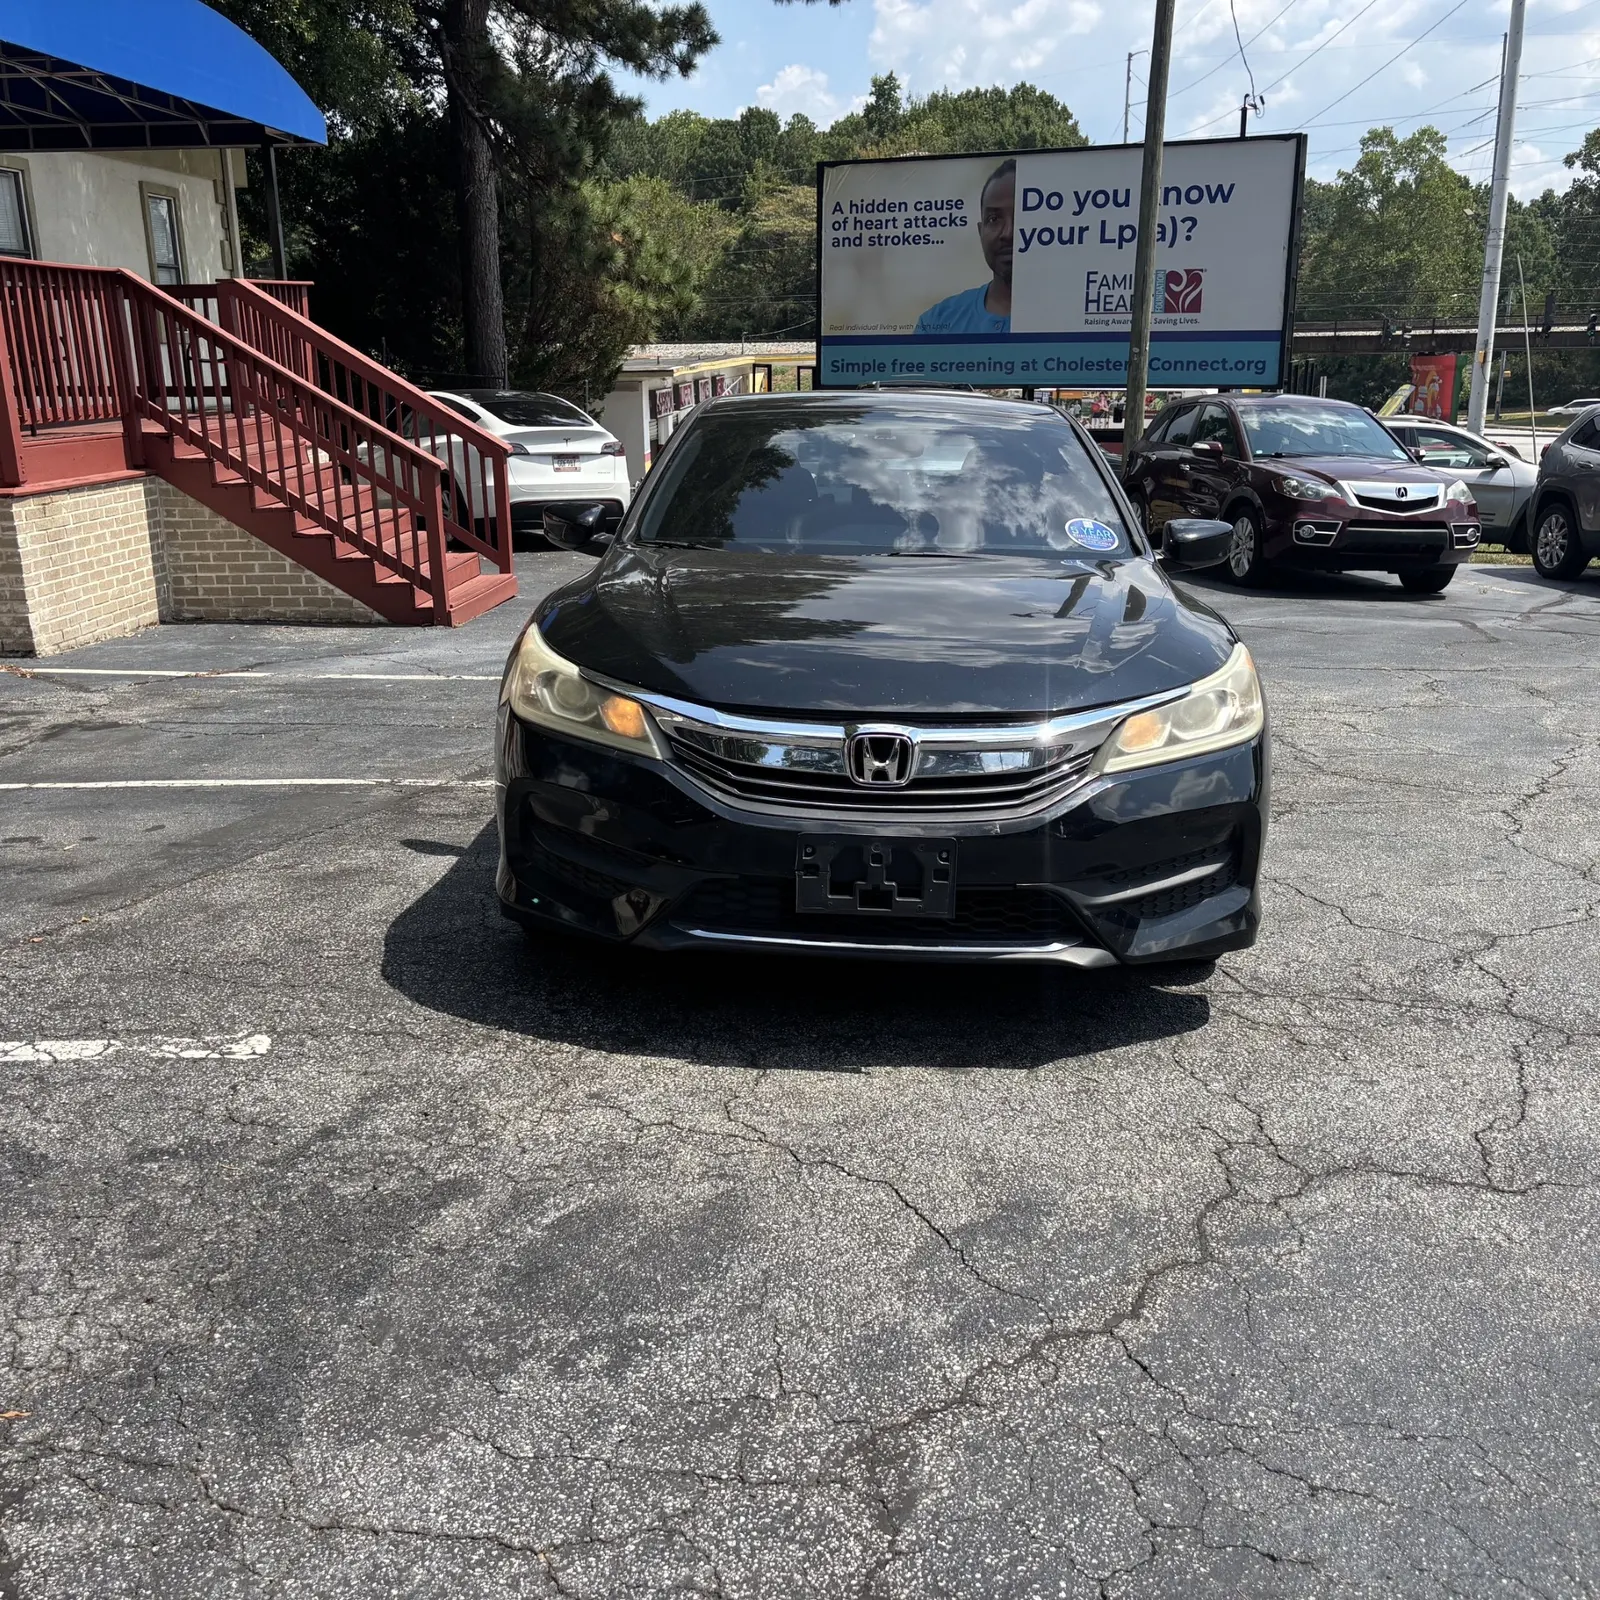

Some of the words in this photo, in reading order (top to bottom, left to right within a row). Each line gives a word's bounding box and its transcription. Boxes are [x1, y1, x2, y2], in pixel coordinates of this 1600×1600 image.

[831, 201, 844, 215] A
[849, 198, 908, 214] hidden
[913, 198, 965, 212] cause
[1022, 187, 1063, 211] Do
[1072, 188, 1130, 216] you
[1159, 183, 1235, 206] now
[831, 216, 849, 231] of
[853, 216, 898, 231] heart
[903, 212, 968, 229] attacks
[831, 233, 863, 248] and
[868, 231, 944, 247] strokes...
[1018, 225, 1089, 253] your
[1100, 215, 1198, 249] Lpa)?
[1086, 271, 1133, 290] FAMI
[845, 323, 879, 331] individual
[879, 323, 897, 332] living
[898, 323, 914, 331] with
[1084, 318, 1109, 326] Raising
[1153, 317, 1178, 326] Saving
[1179, 317, 1200, 325] Lives.
[830, 358, 886, 376] Simple
[891, 357, 925, 373] free
[930, 357, 1015, 375] screening
[1021, 358, 1038, 372] at
[1043, 356, 1267, 375] CholesterConnect.org
[1070, 525, 1079, 535] 5
[1080, 527, 1112, 539] YEAR
